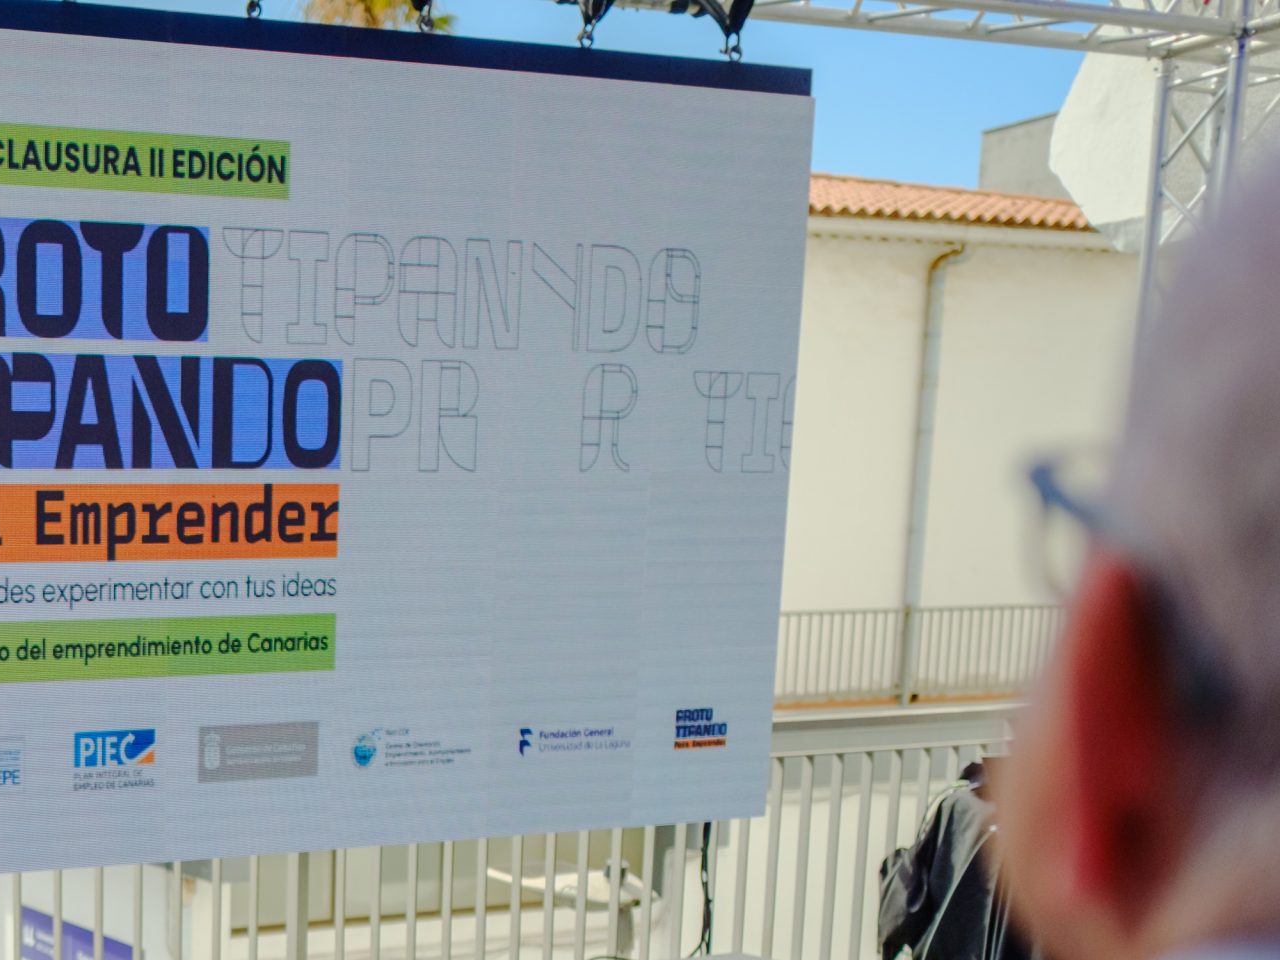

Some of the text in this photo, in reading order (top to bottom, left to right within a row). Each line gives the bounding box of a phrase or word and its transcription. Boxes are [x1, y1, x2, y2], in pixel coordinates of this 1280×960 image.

[149, 147, 165, 177] II
[172, 143, 286, 184] EDICIÓN
[35, 483, 339, 561] Emprender
[42, 577, 194, 610] experimentar
[200, 579, 238, 599] con
[246, 574, 276, 599] tus
[282, 571, 337, 597] ideas
[16, 638, 46, 661] del
[52, 634, 213, 666] emprendimiento
[218, 632, 242, 655] de
[247, 631, 329, 653] Canarias
[80, 731, 138, 769] PIEC
[539, 726, 614, 739] Fundación General
